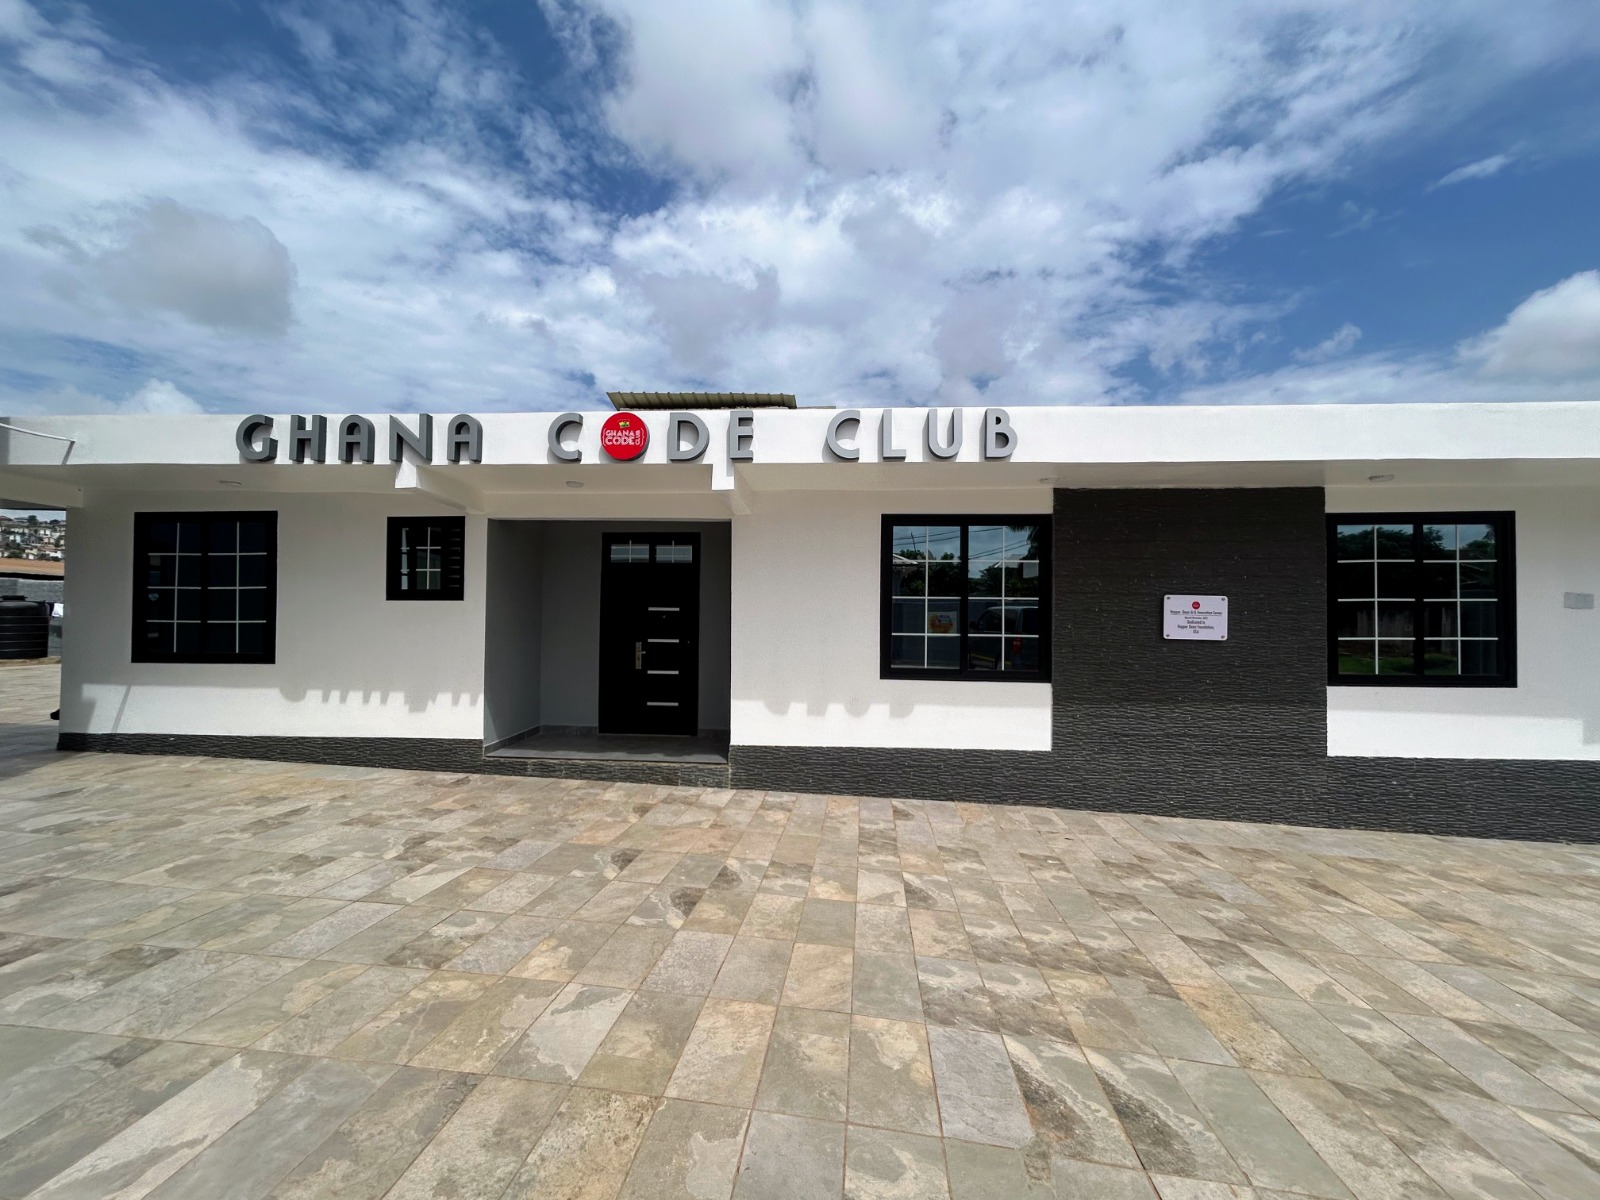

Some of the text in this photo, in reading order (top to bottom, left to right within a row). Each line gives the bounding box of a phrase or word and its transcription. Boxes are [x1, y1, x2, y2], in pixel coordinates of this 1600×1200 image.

[235, 413, 483, 463] GHANA
[826, 408, 1018, 462] CLUB
[605, 429, 635, 437] GHANA
[605, 436, 635, 445] CODE
